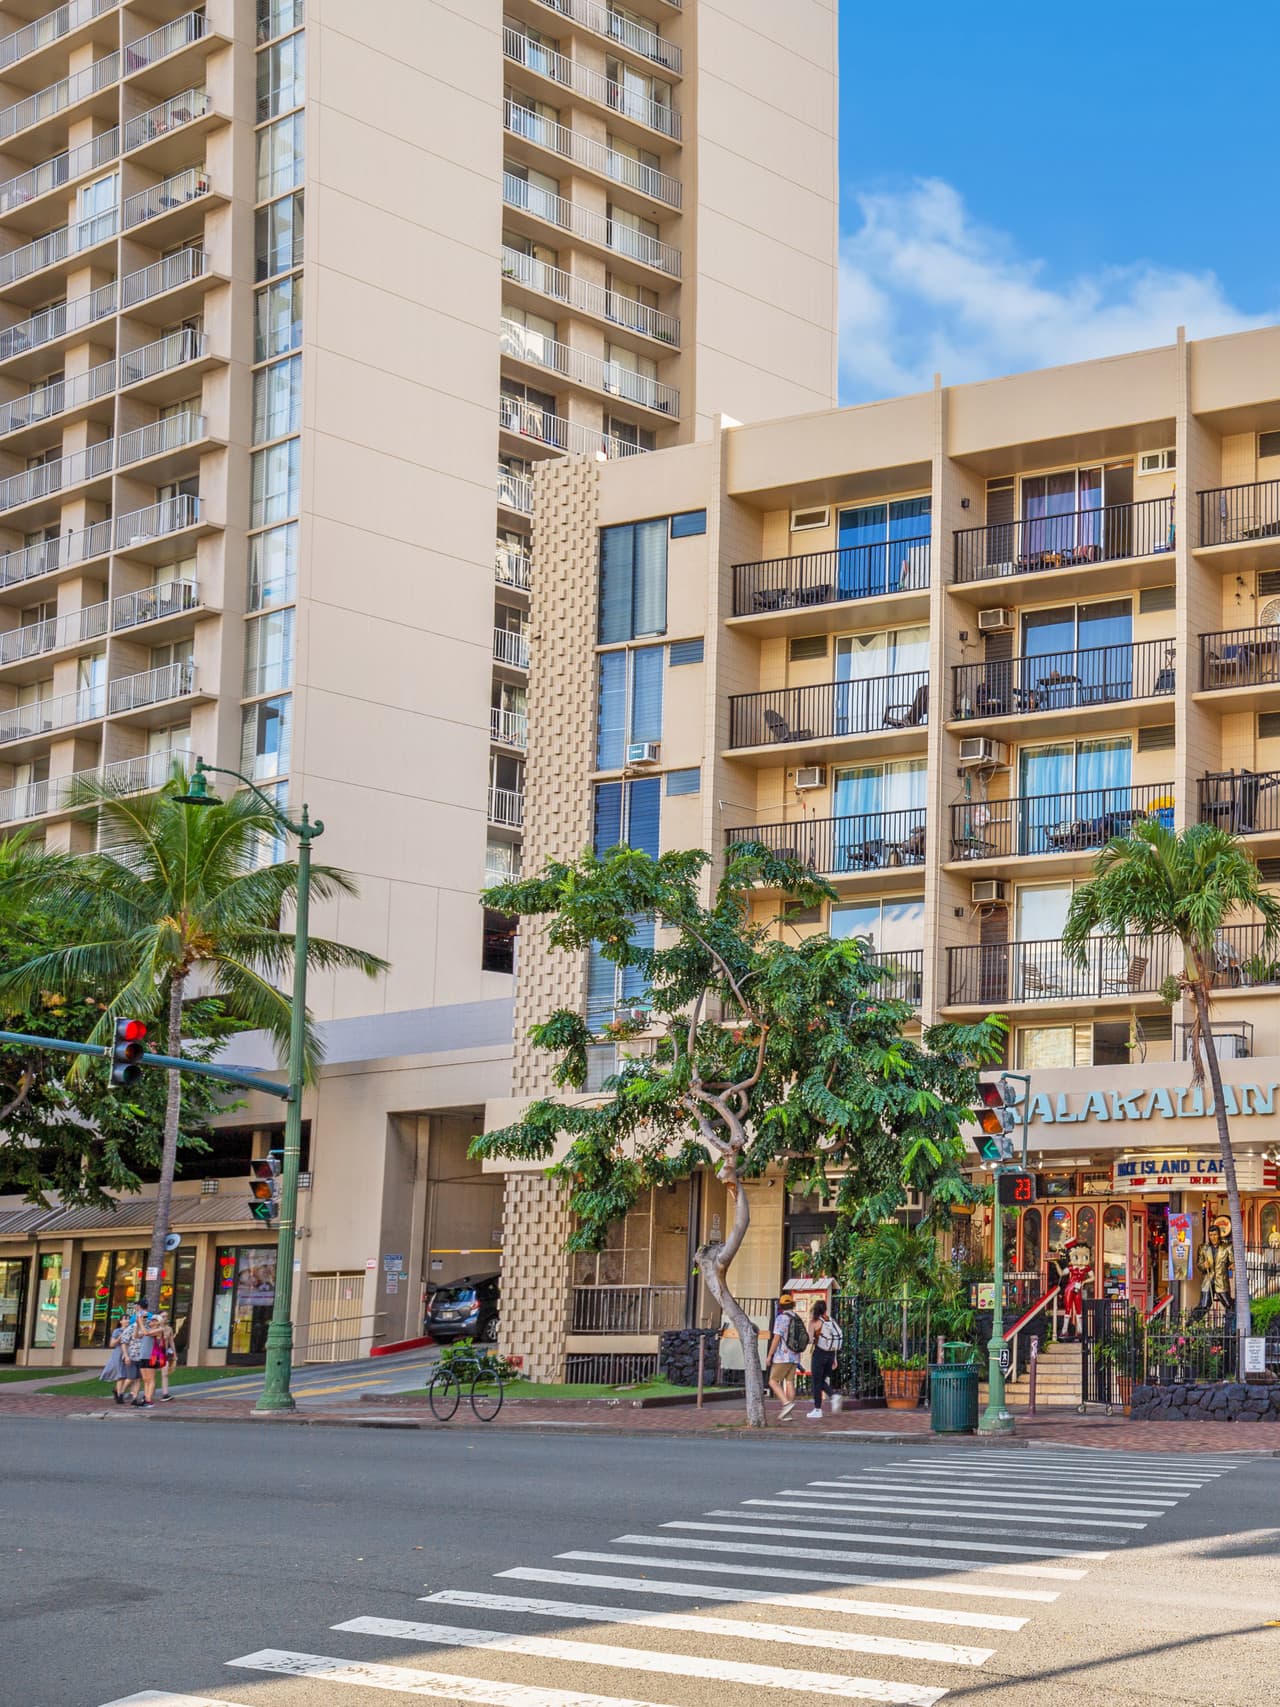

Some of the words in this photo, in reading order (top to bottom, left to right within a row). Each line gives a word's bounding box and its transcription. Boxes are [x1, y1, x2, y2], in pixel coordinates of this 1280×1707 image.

[1141, 1159, 1190, 1175] ISLAND
[1197, 1158, 1237, 1174] CAF
[1157, 1176, 1174, 1185] EAT
[1189, 1176, 1218, 1185] DRINK
